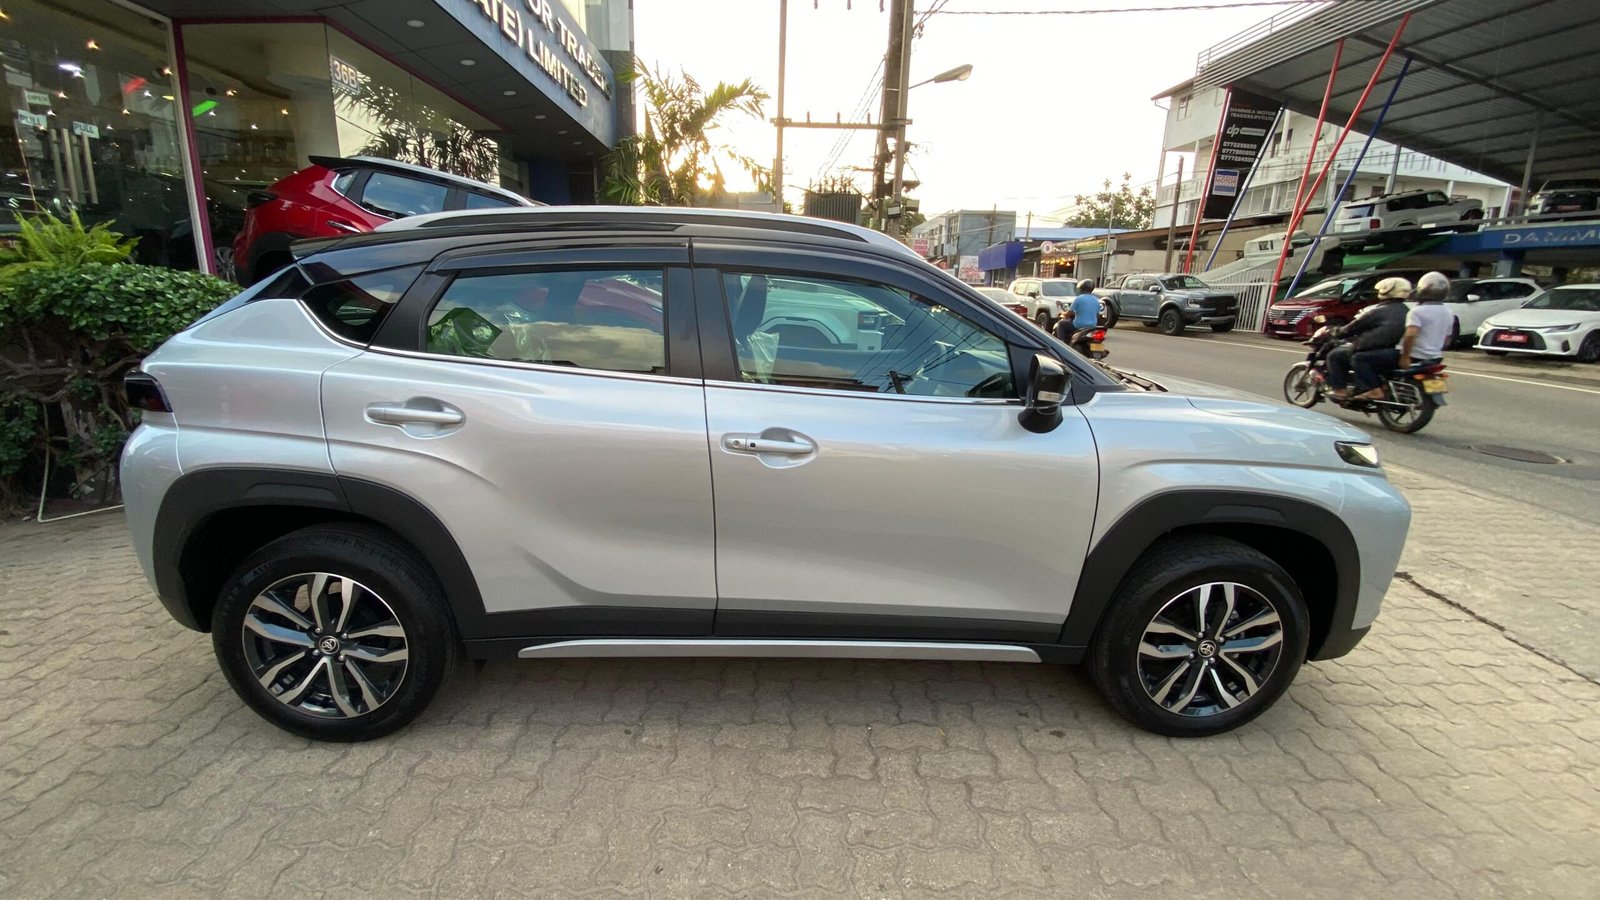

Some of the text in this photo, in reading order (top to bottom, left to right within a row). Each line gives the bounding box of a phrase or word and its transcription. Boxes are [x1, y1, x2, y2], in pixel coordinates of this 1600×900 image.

[526, 28, 588, 107] LIMITED
[556, 17, 613, 100] TRADERS
[74, 122, 94, 134] PULL
